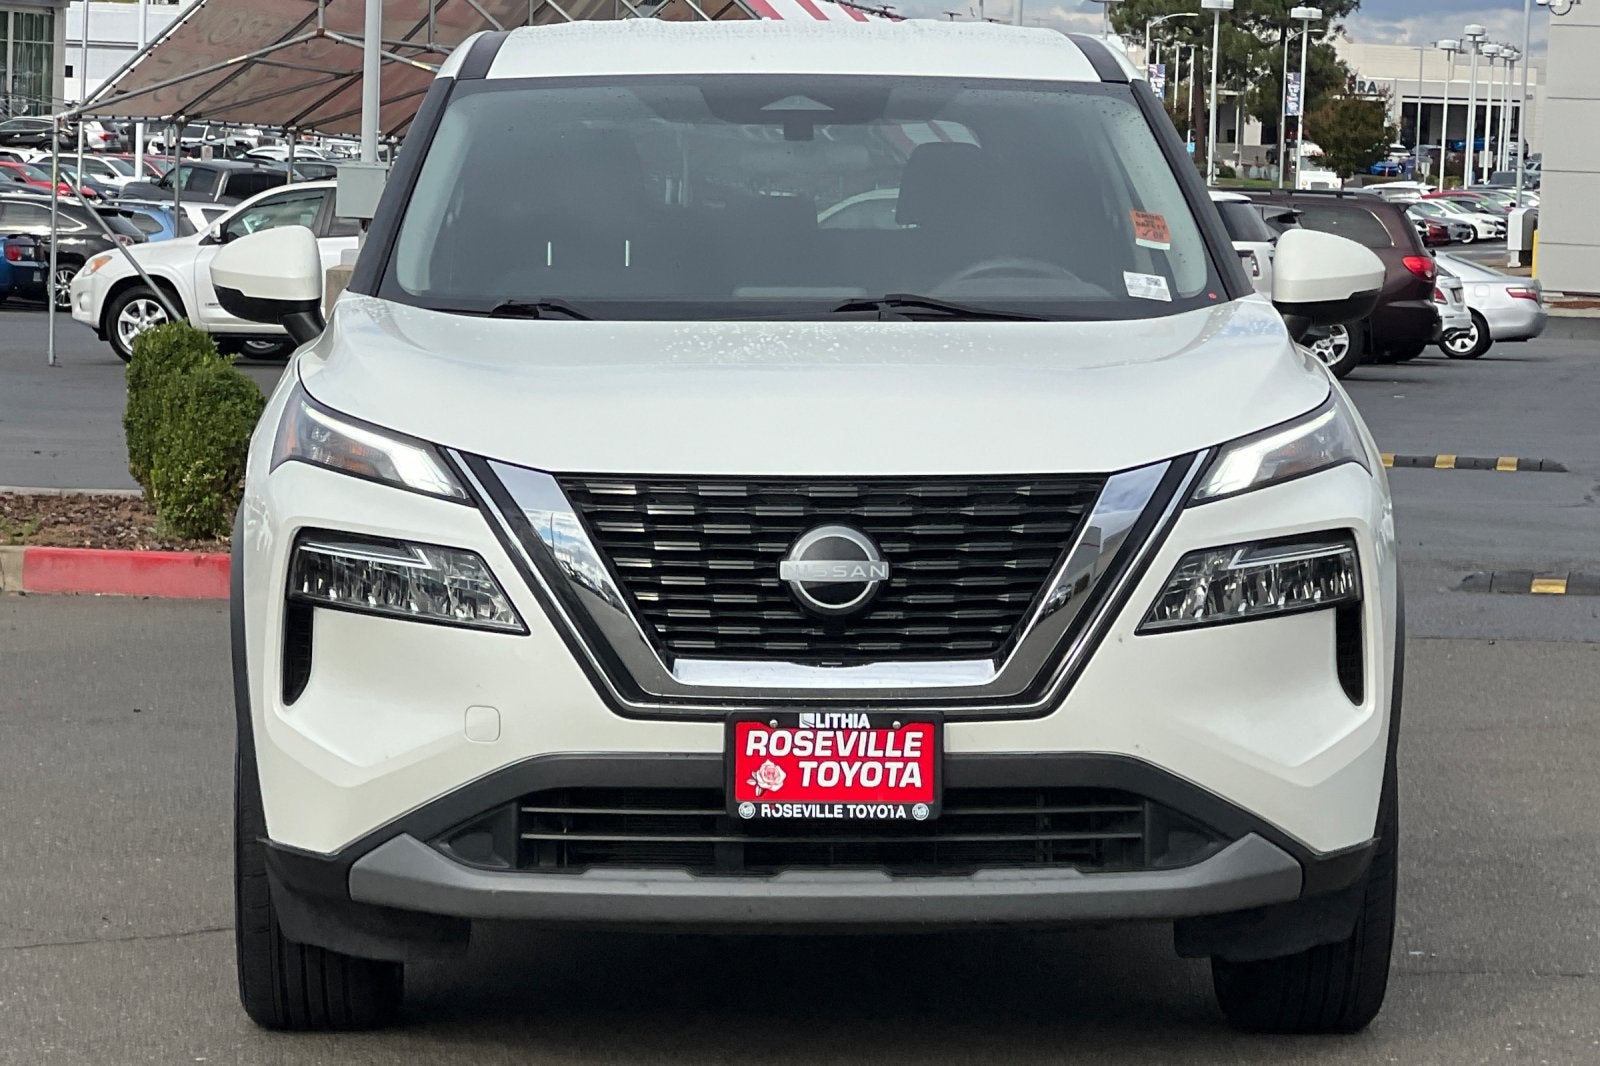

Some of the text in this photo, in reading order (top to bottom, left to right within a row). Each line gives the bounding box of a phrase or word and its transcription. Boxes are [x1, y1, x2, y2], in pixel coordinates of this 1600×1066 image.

[781, 564, 887, 578] NISSAN
[816, 712, 871, 729] LITHIA
[745, 730, 924, 758] ROSEVILLE
[798, 761, 922, 788] TOYOTA
[760, 803, 907, 819] ROSEVILLE TOYOTA
